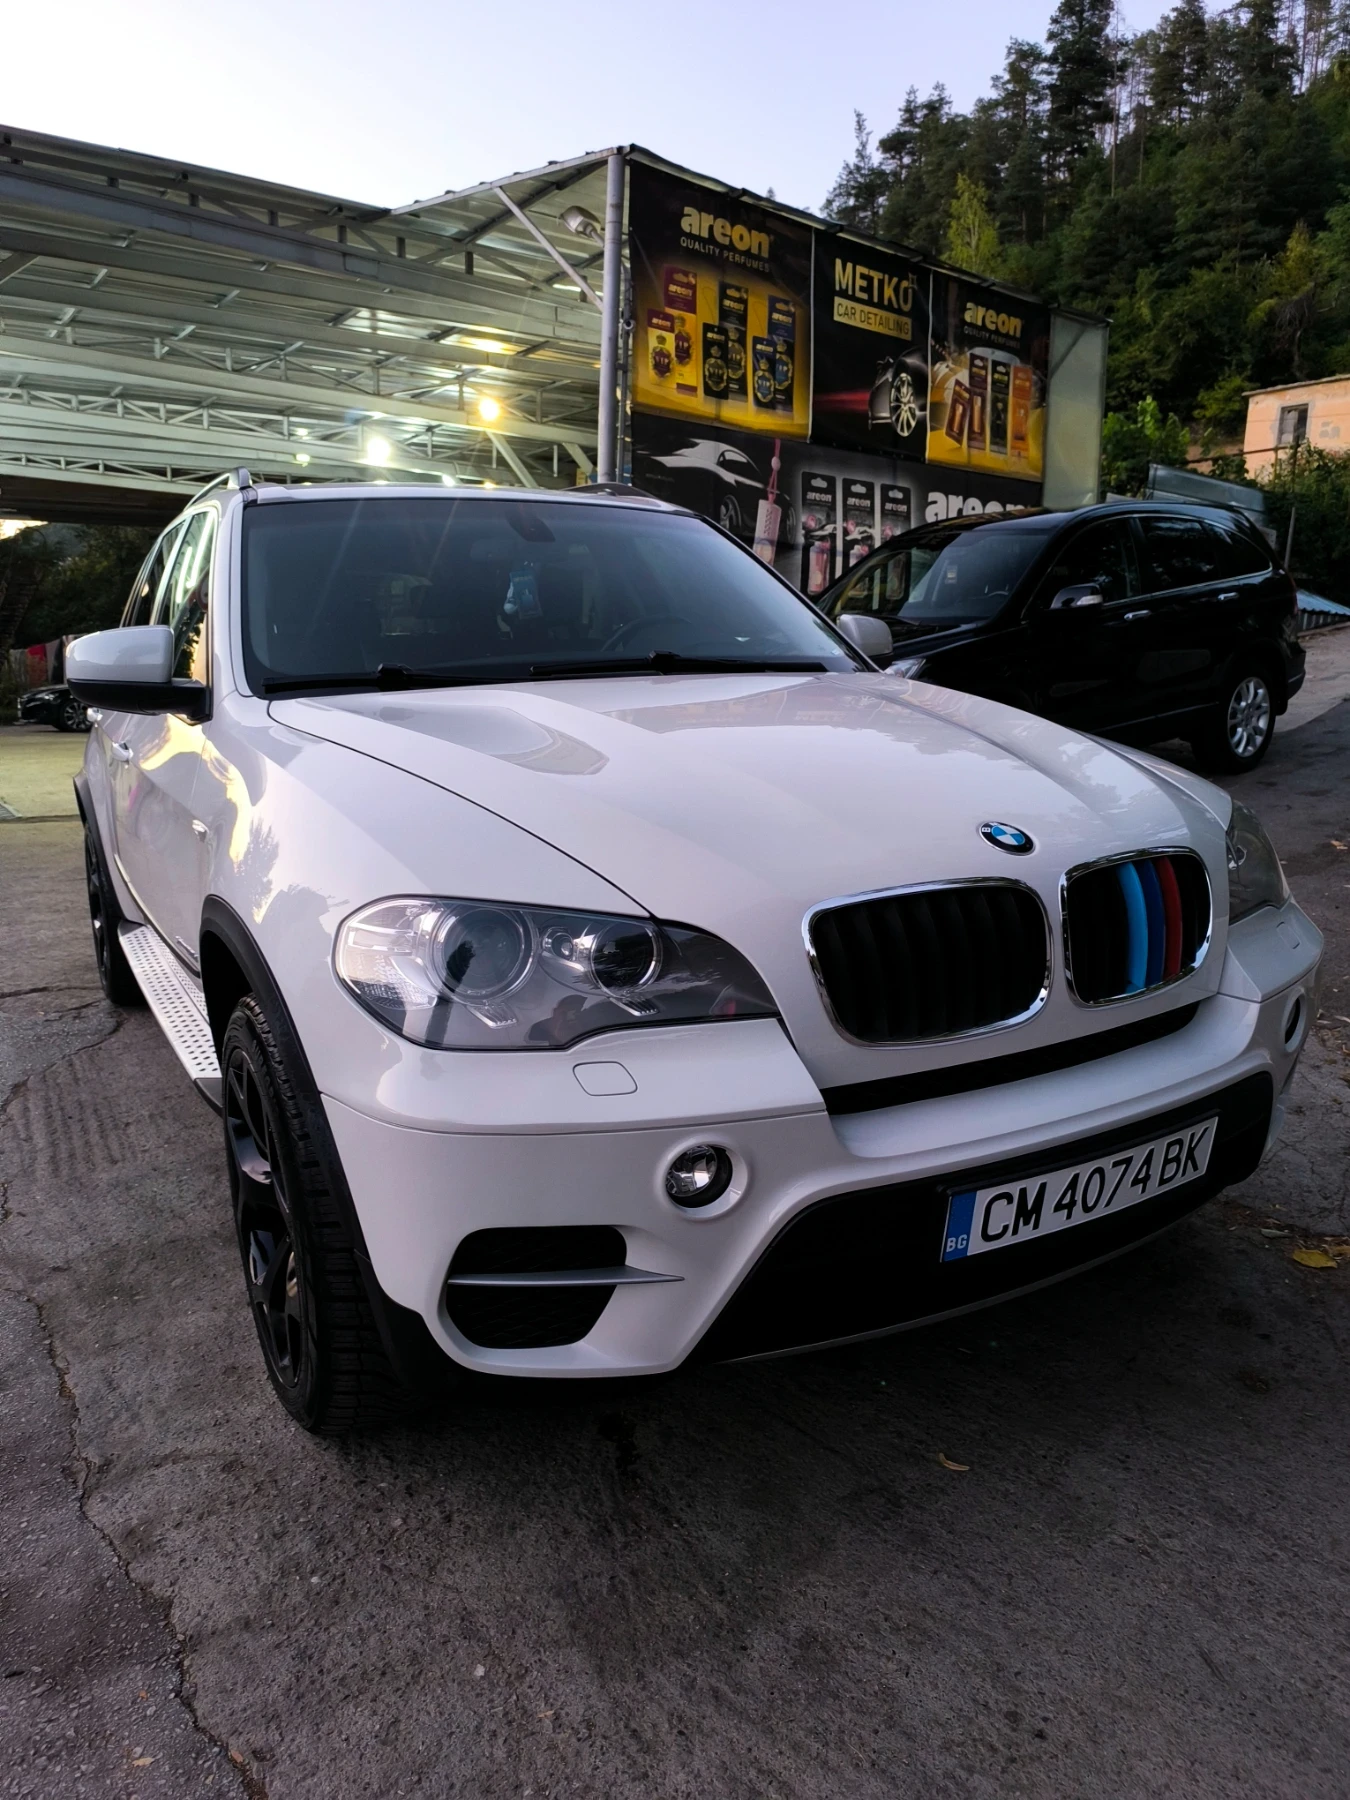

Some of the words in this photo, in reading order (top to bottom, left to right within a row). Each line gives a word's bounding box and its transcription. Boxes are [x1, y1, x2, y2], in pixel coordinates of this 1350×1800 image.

[681, 206, 770, 258] areon
[680, 237, 719, 256] QUALITY
[723, 250, 770, 272] PERFUMES
[835, 257, 913, 312] METKO
[837, 303, 857, 320] CAR
[860, 309, 909, 335] DETAILING
[964, 302, 1021, 338] areon
[806, 491, 832, 502] areon
[847, 497, 871, 508] areon
[925, 492, 1025, 523] are
[1053, 1145, 1156, 1221] 4074
[946, 1234, 968, 1253] BG
